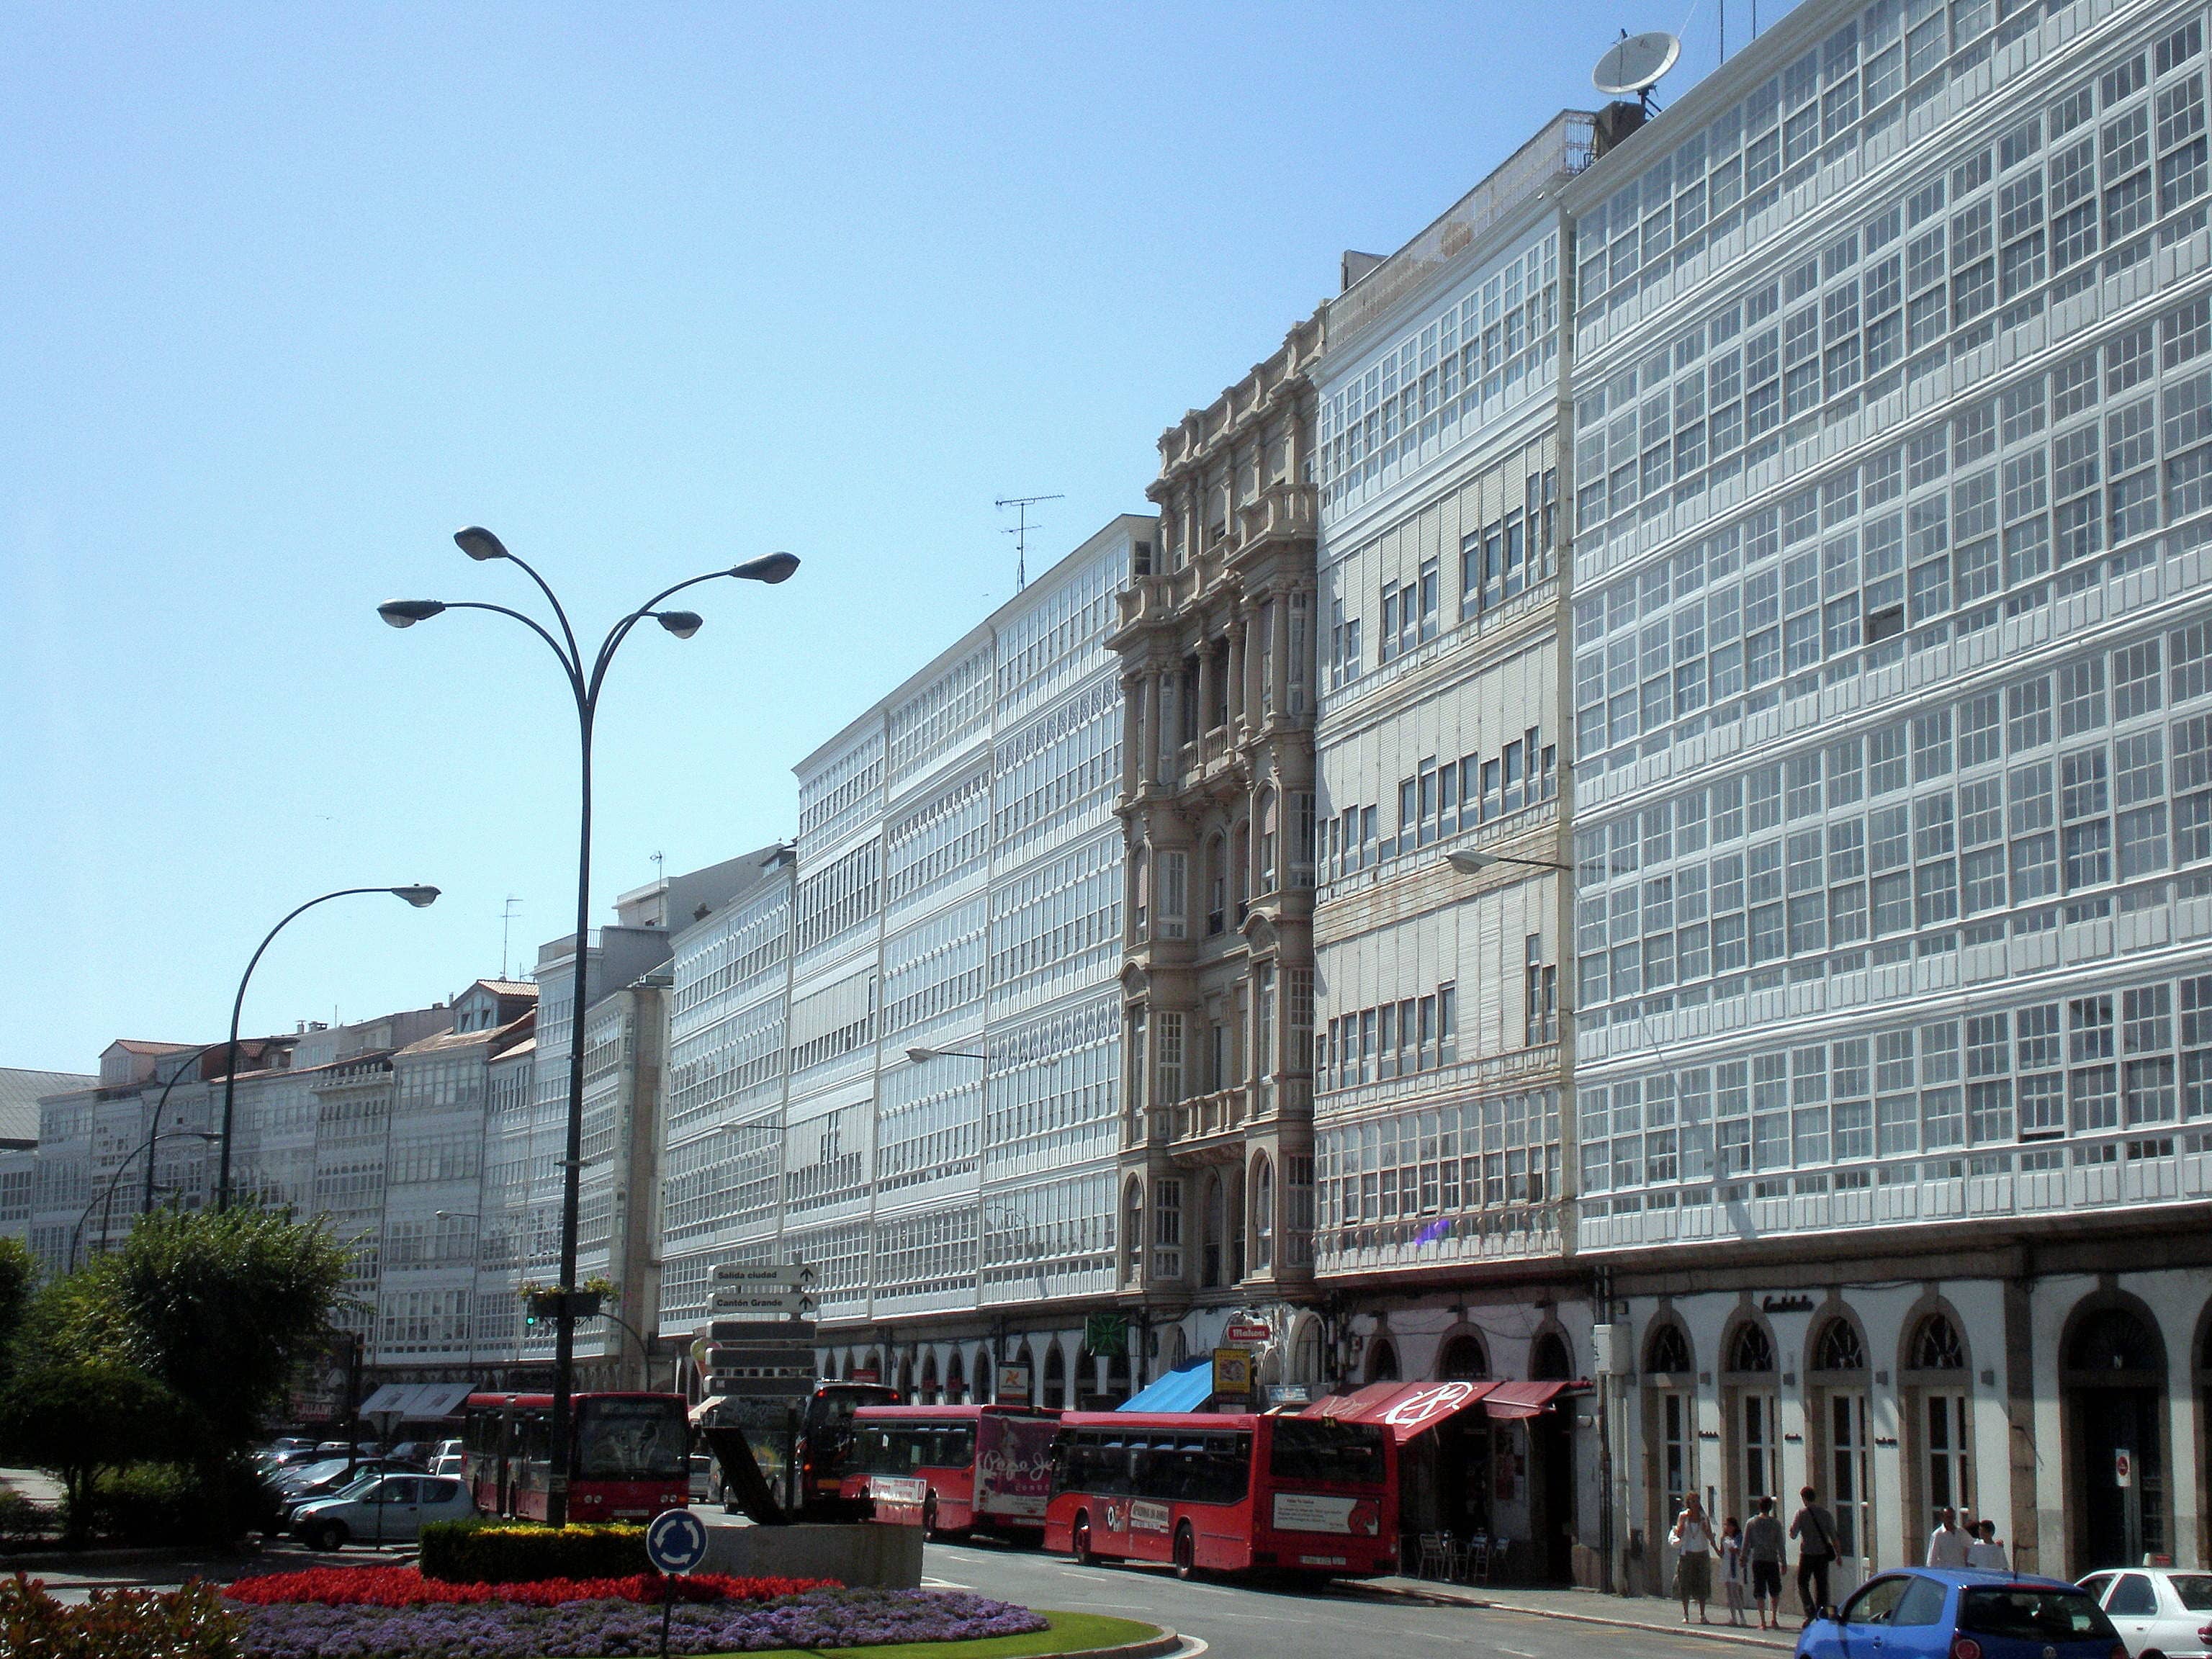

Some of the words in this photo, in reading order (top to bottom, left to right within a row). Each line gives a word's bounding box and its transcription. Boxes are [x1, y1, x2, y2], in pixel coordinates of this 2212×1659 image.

[719, 1271, 745, 1280] Salida
[747, 1270, 777, 1279] ciudad
[716, 1298, 748, 1307] Cantón
[750, 1298, 783, 1307] Grande
